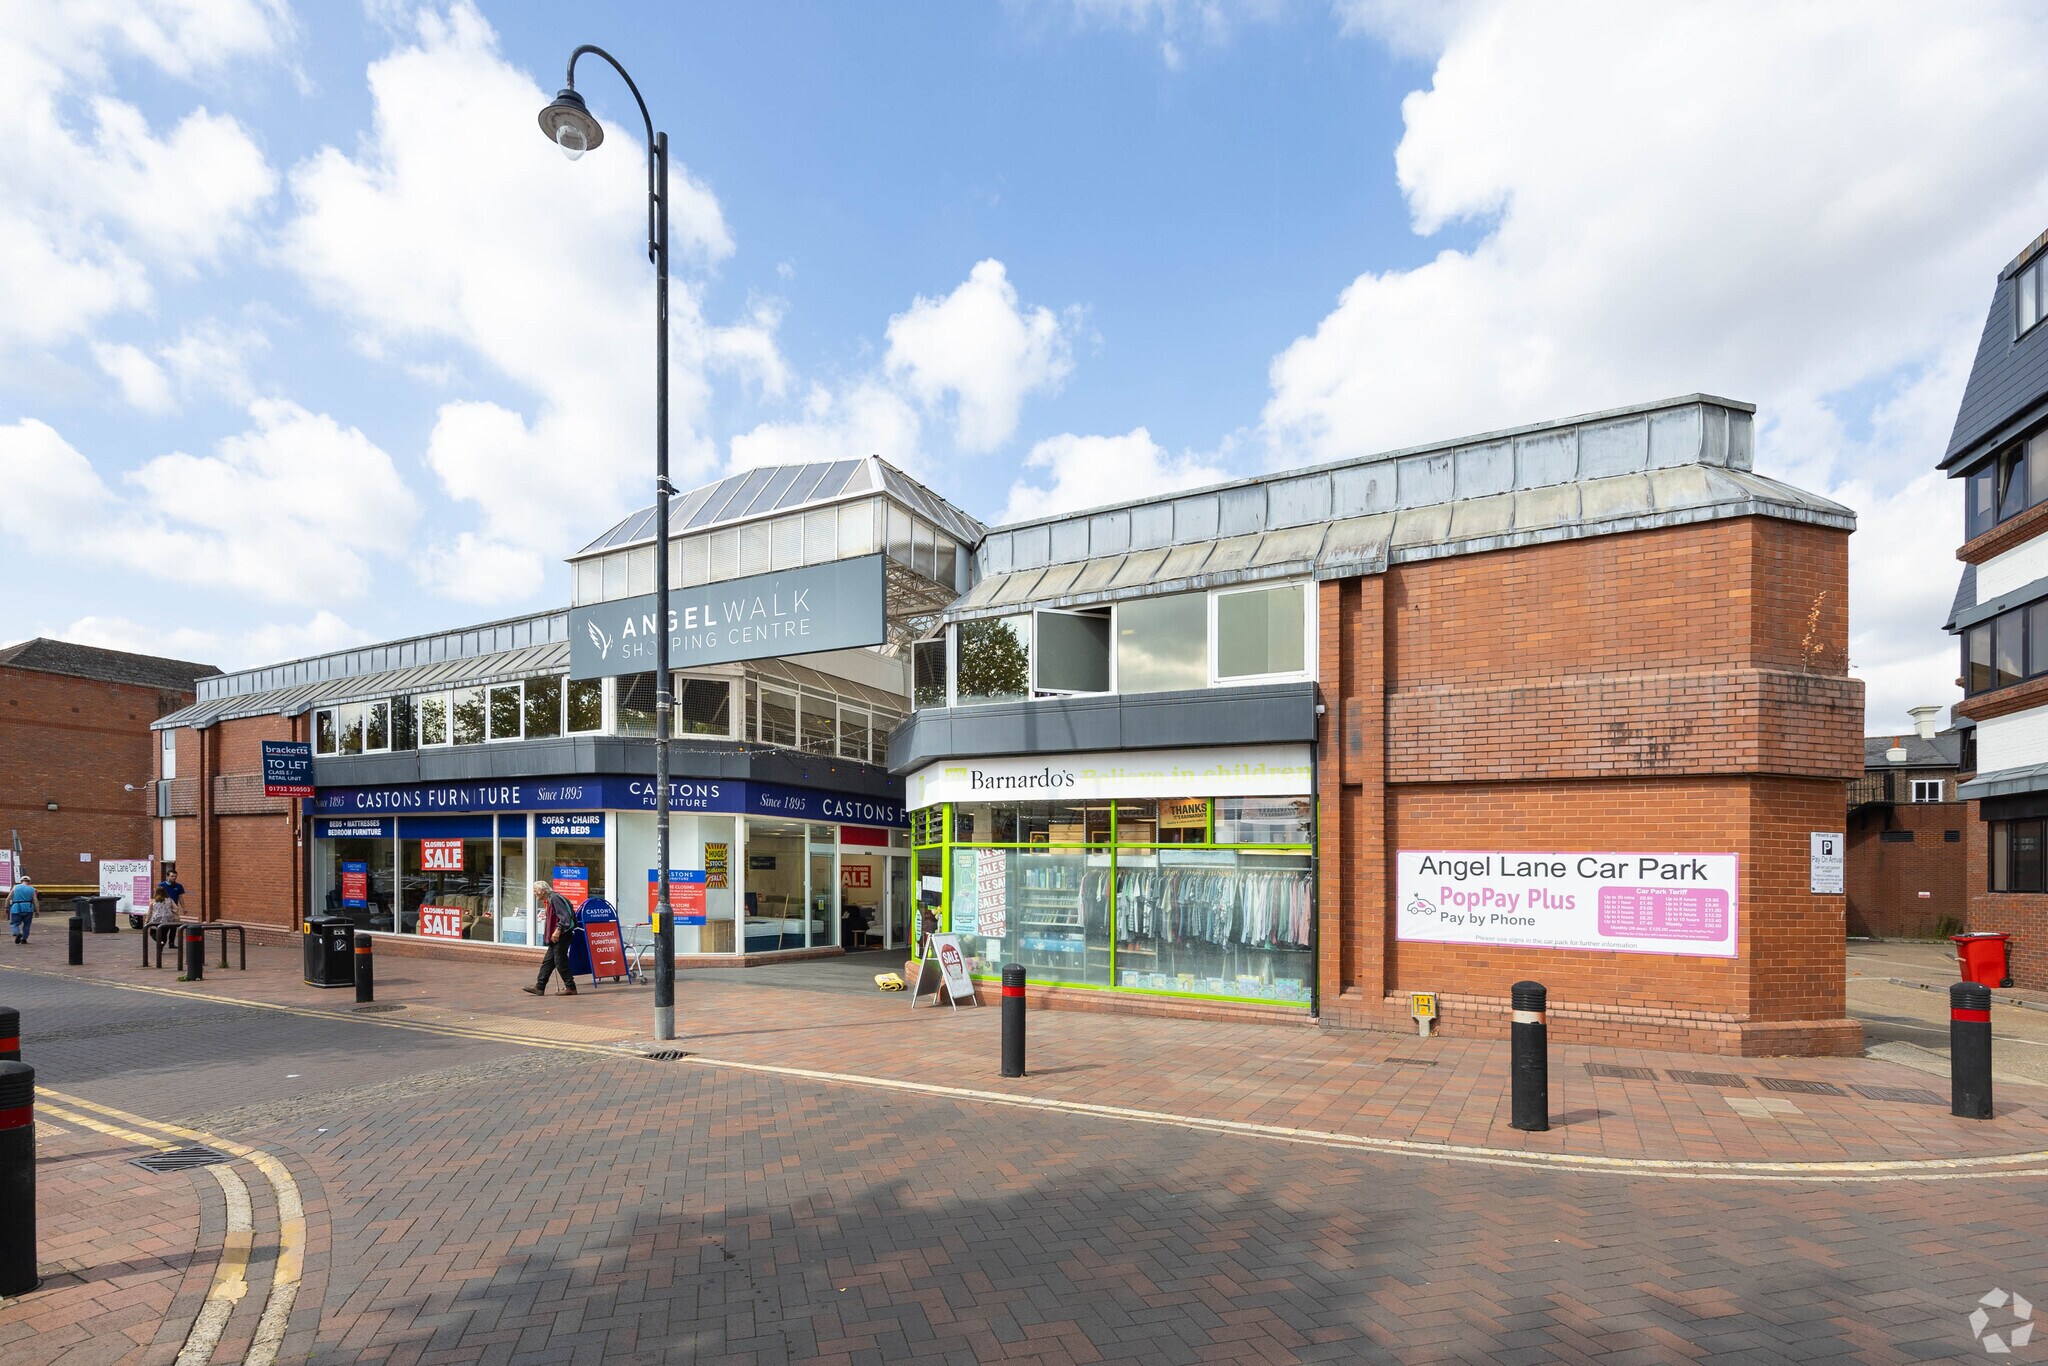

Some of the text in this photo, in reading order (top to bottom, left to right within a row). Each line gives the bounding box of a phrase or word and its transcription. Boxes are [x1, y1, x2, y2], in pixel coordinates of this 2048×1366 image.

[622, 618, 811, 659] SHOPING CENTRE
[266, 745, 308, 754] bracketts
[267, 760, 308, 770] TO LET
[971, 767, 1074, 790] Barnardo's
[1170, 766, 1194, 784] in
[1203, 762, 1311, 783] children
[356, 786, 520, 808] CASTONS FURNITURE
[537, 786, 582, 801] Since 1895
[629, 782, 720, 798] CATONS
[329, 796, 345, 807] 1895
[643, 798, 707, 807] FUNITURE
[760, 793, 806, 810] Since 1895
[1170, 803, 1207, 815] THANKS
[822, 799, 893, 821] CASTONS
[542, 815, 600, 824] SOFAS CHAIRS
[571, 826, 590, 834] BEDS
[424, 848, 462, 868] SALE
[103, 863, 148, 874] Angel Lane Car Park
[1419, 856, 1708, 881] Angel Lane Car Park
[842, 872, 868, 886] ALE
[108, 882, 123, 893] PopPay
[1440, 886, 1575, 913] PopPay Plus
[423, 914, 460, 936] SALE
[1440, 912, 1536, 926] Pay by Phone
[942, 950, 960, 963] SALE
[1416, 998, 1430, 1013] H
